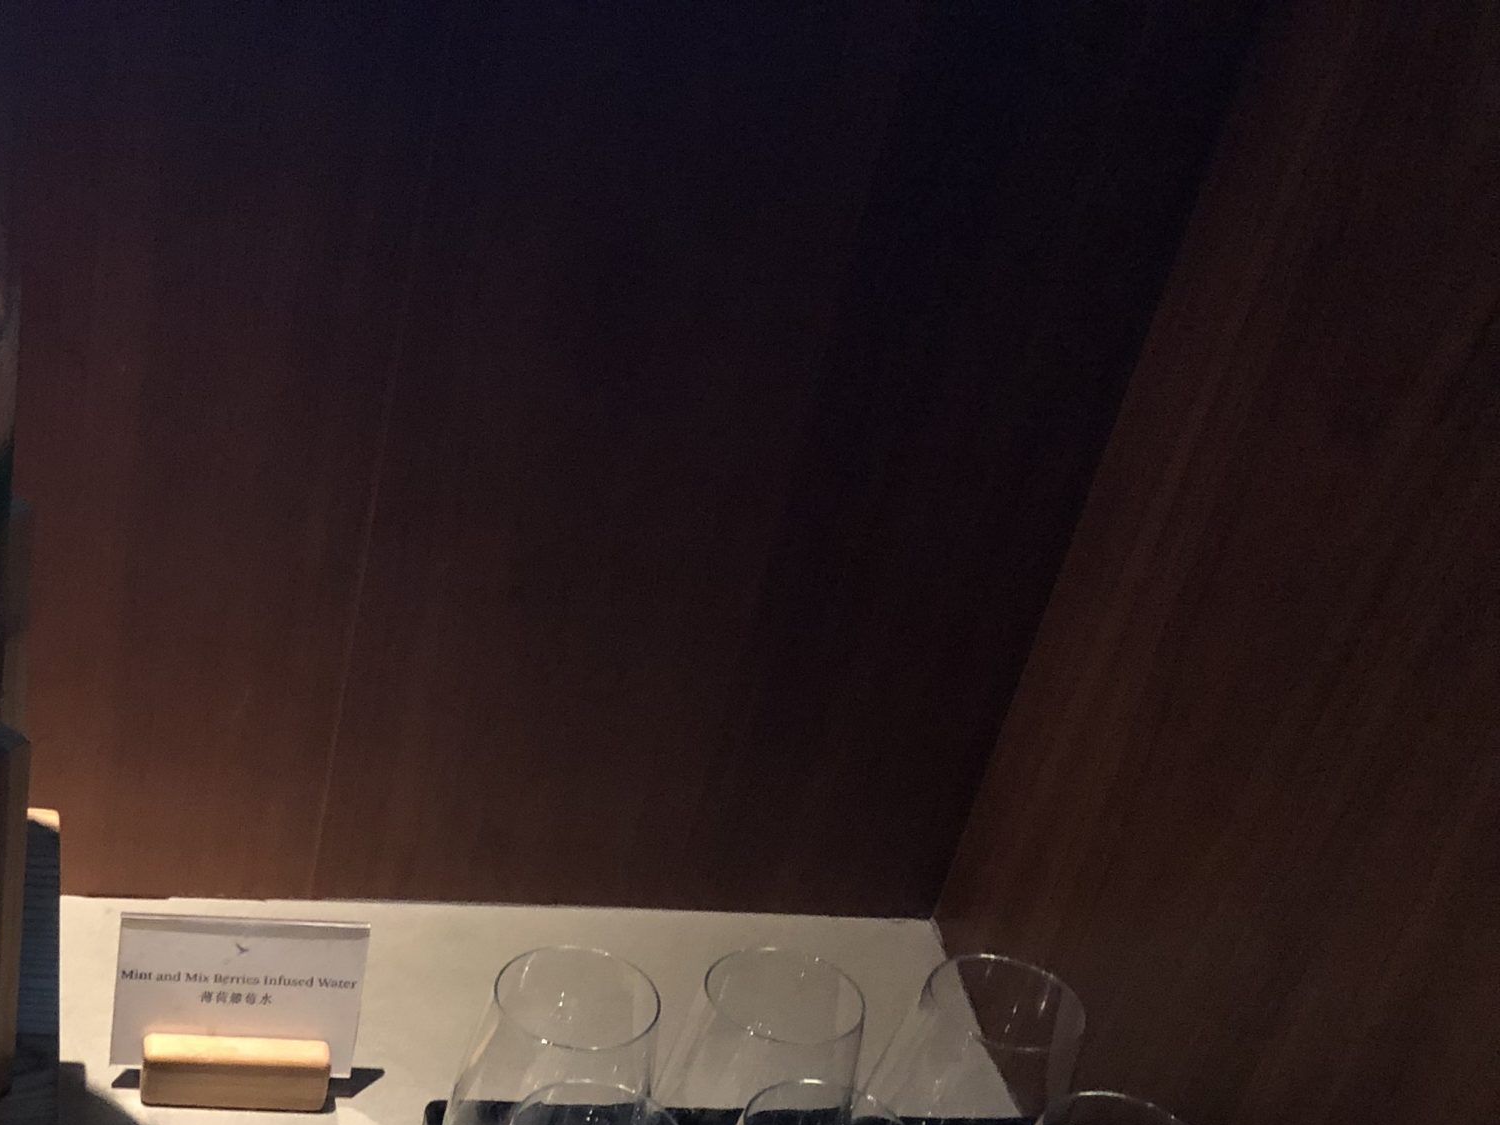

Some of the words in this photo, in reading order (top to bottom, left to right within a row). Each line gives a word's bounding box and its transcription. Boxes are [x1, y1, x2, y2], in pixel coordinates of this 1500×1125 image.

[121, 969, 152, 980] Mint
[156, 971, 181, 982] and
[185, 973, 208, 983] Mix
[214, 974, 260, 986] Berries
[264, 975, 314, 987] Infused
[317, 978, 358, 989] Water
